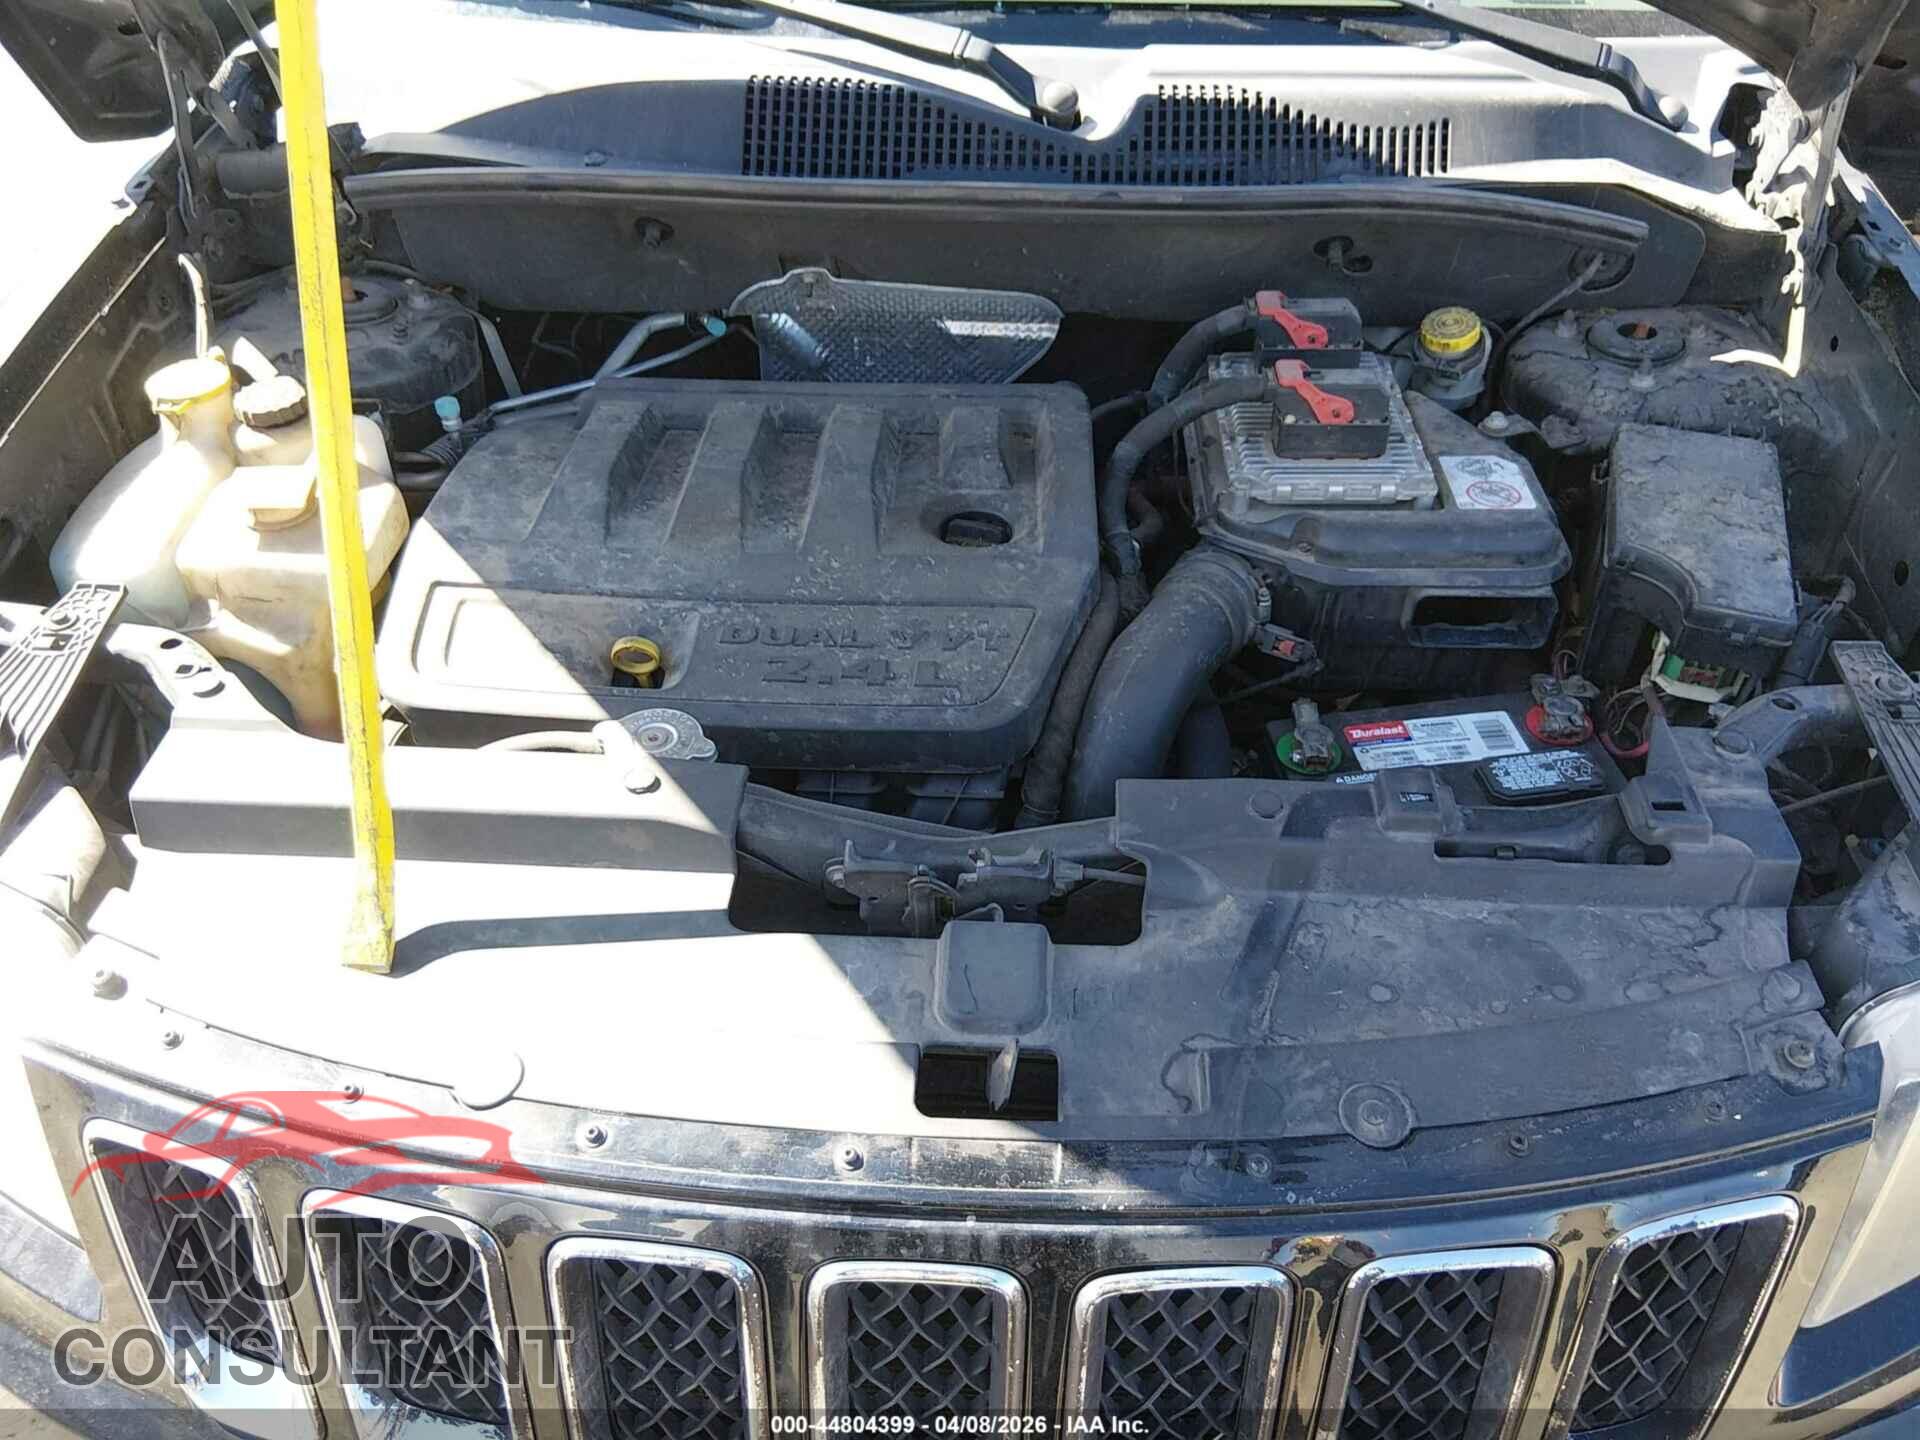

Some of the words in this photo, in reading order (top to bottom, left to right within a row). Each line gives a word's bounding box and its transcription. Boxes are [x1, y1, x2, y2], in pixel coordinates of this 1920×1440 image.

[718, 624, 874, 650] DUAL
[761, 658, 960, 690] 2.4L
[1349, 724, 1404, 739] Duralast
